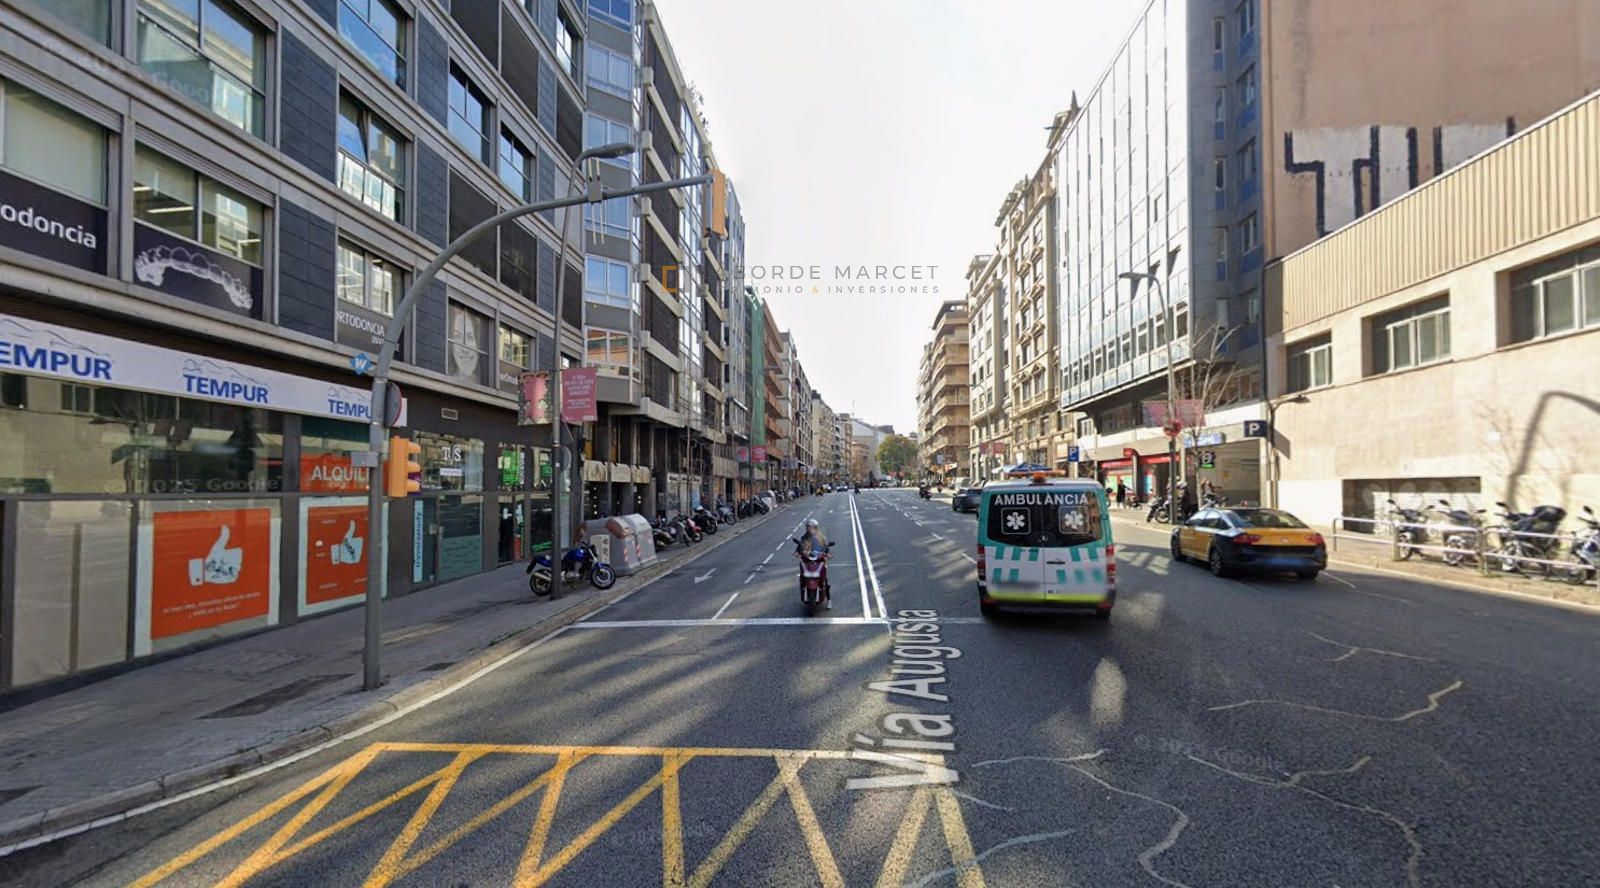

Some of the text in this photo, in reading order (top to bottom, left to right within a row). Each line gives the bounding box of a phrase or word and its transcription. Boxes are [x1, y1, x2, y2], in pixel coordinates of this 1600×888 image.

[0, 203, 97, 249] odoncia
[0, 340, 113, 380] EMPUR
[182, 373, 269, 404] TEMPUR
[327, 399, 372, 420] TEMPU
[1248, 422, 1261, 436] P
[1068, 447, 1078, 458] P
[311, 464, 370, 482] ALQUIL
